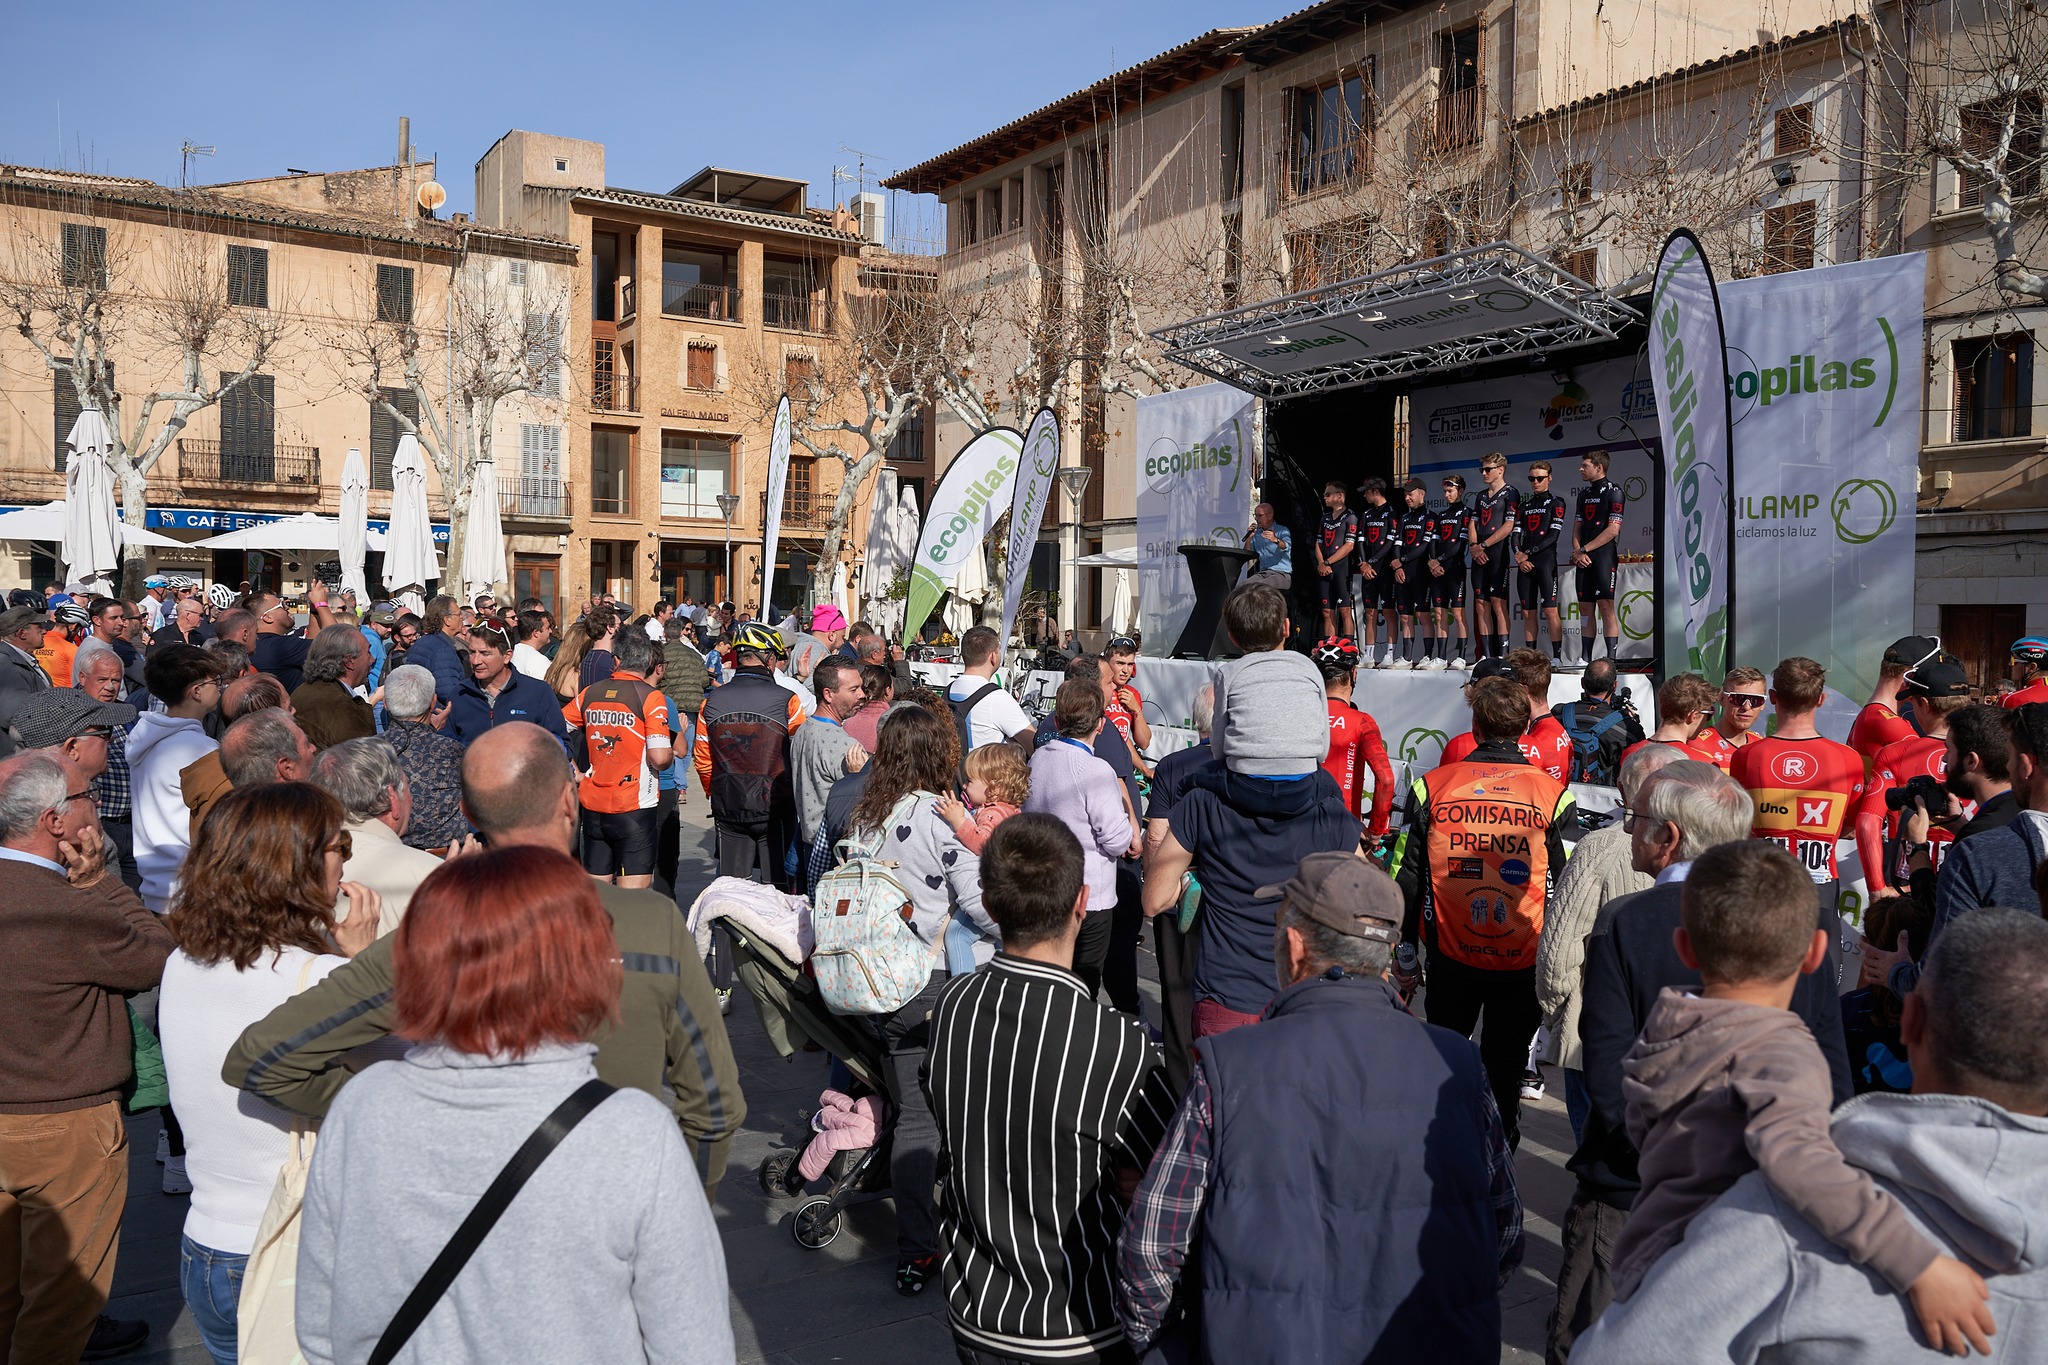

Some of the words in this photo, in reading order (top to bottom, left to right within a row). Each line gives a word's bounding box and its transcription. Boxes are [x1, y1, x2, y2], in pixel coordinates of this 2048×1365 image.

[1372, 304, 1471, 331] AMBILAMP
[1250, 335, 1346, 357] ecopilas
[1728, 354, 1876, 406] opilas
[660, 407, 696, 418] GALERIA
[698, 411, 729, 422] MAIOR
[1436, 408, 1458, 416] GARDEN
[1459, 405, 1480, 413] HOTELS
[1484, 401, 1510, 409] LUXCOM
[1539, 403, 1594, 419] Mallorca
[1574, 414, 1593, 422] Balears
[1428, 413, 1511, 433] Challenge
[1429, 434, 1471, 445] FEMENINA
[1145, 443, 1232, 478] ecopilas
[929, 455, 1016, 562] ecopilas
[1524, 508, 1547, 516] TUDOR
[1734, 494, 1820, 520] ILAMP
[186, 514, 231, 528] CAFÉ
[1007, 479, 1036, 585] AMBILAMP
[1735, 526, 1785, 538] ciclamos
[1788, 525, 1797, 538] la
[1799, 525, 1817, 537] luz
[1346, 741, 1356, 770] HOTELS
[1783, 757, 1806, 777] R
[1344, 773, 1353, 790] B&B
[1435, 804, 1545, 830] COMISARIO
[1760, 802, 1789, 814] Uno
[1801, 801, 1829, 825] X
[1450, 832, 1531, 856] PRENSA
[1500, 867, 1529, 877] Carmax
[1464, 885, 1514, 901] motosenlace.com
